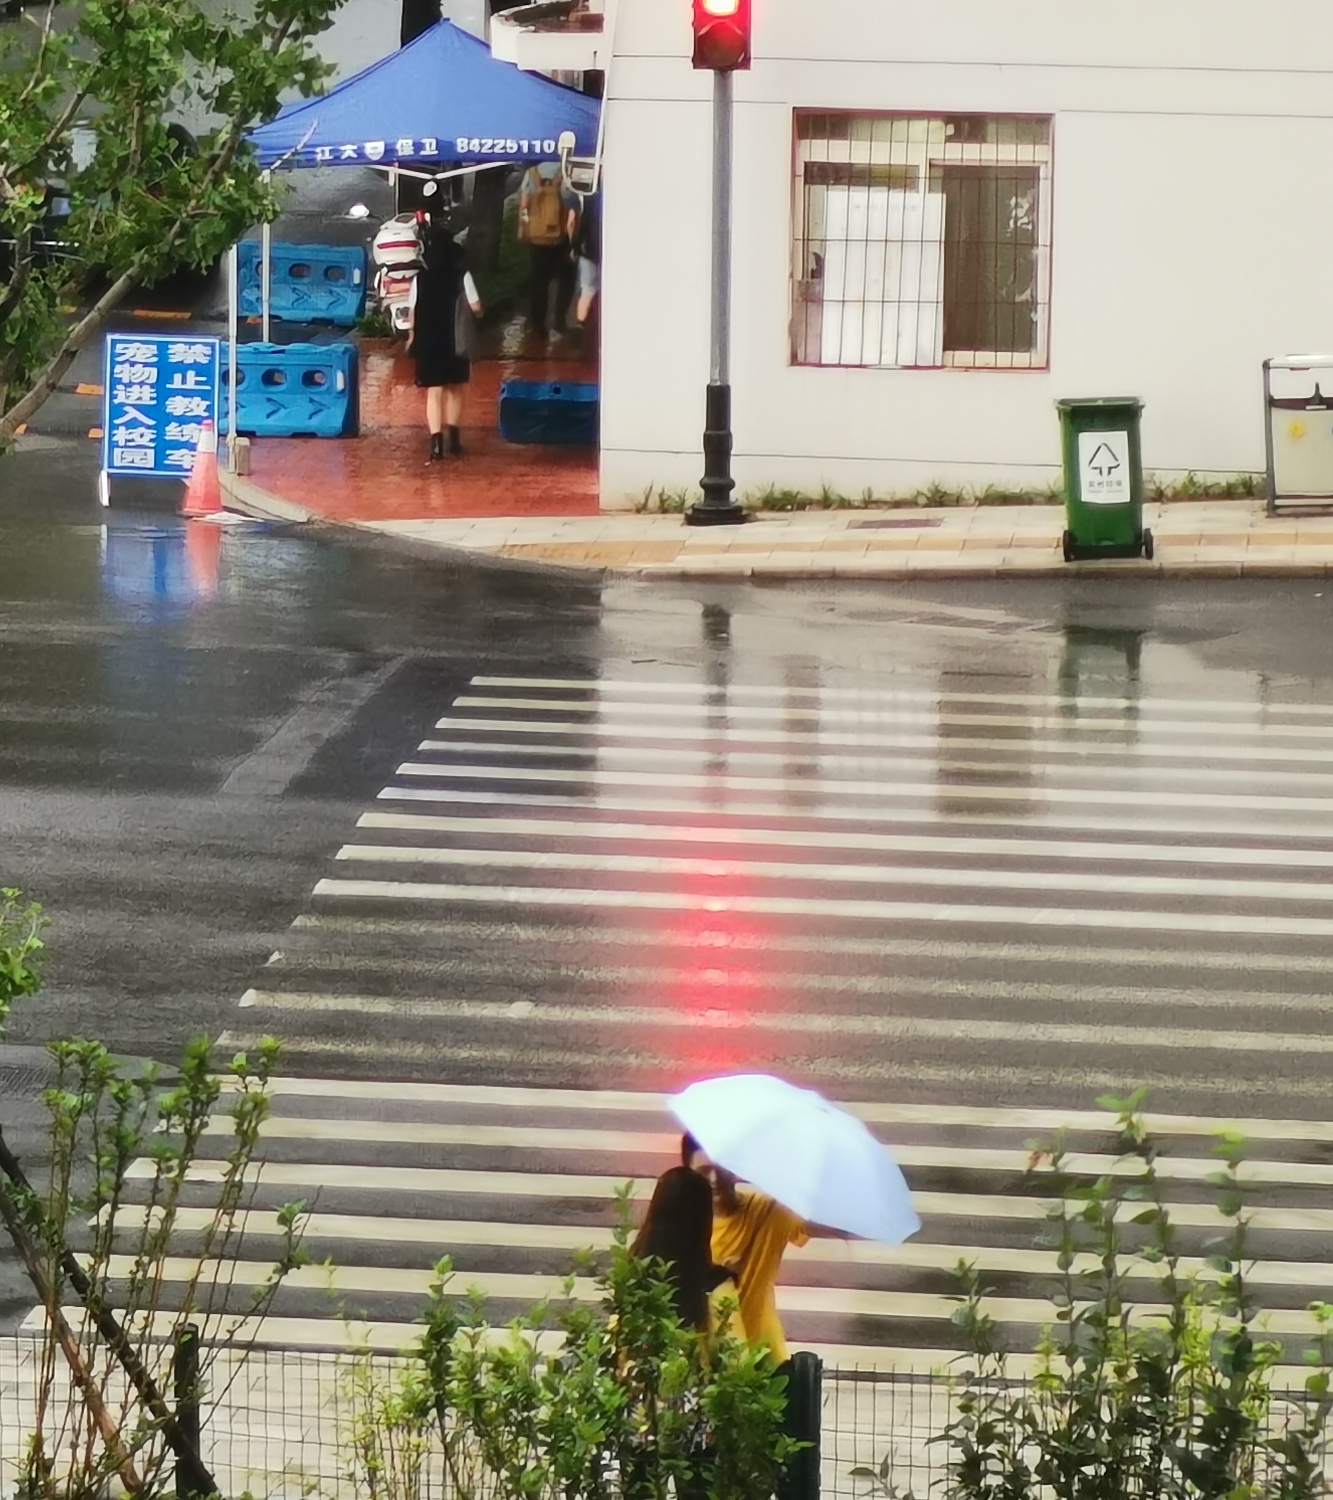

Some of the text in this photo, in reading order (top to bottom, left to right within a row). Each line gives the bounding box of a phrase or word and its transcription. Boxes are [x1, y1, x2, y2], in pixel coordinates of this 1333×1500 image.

[396, 138, 438, 156] 保卫
[455, 136, 556, 154] 84225110
[111, 342, 160, 469] 宠物进入校园
